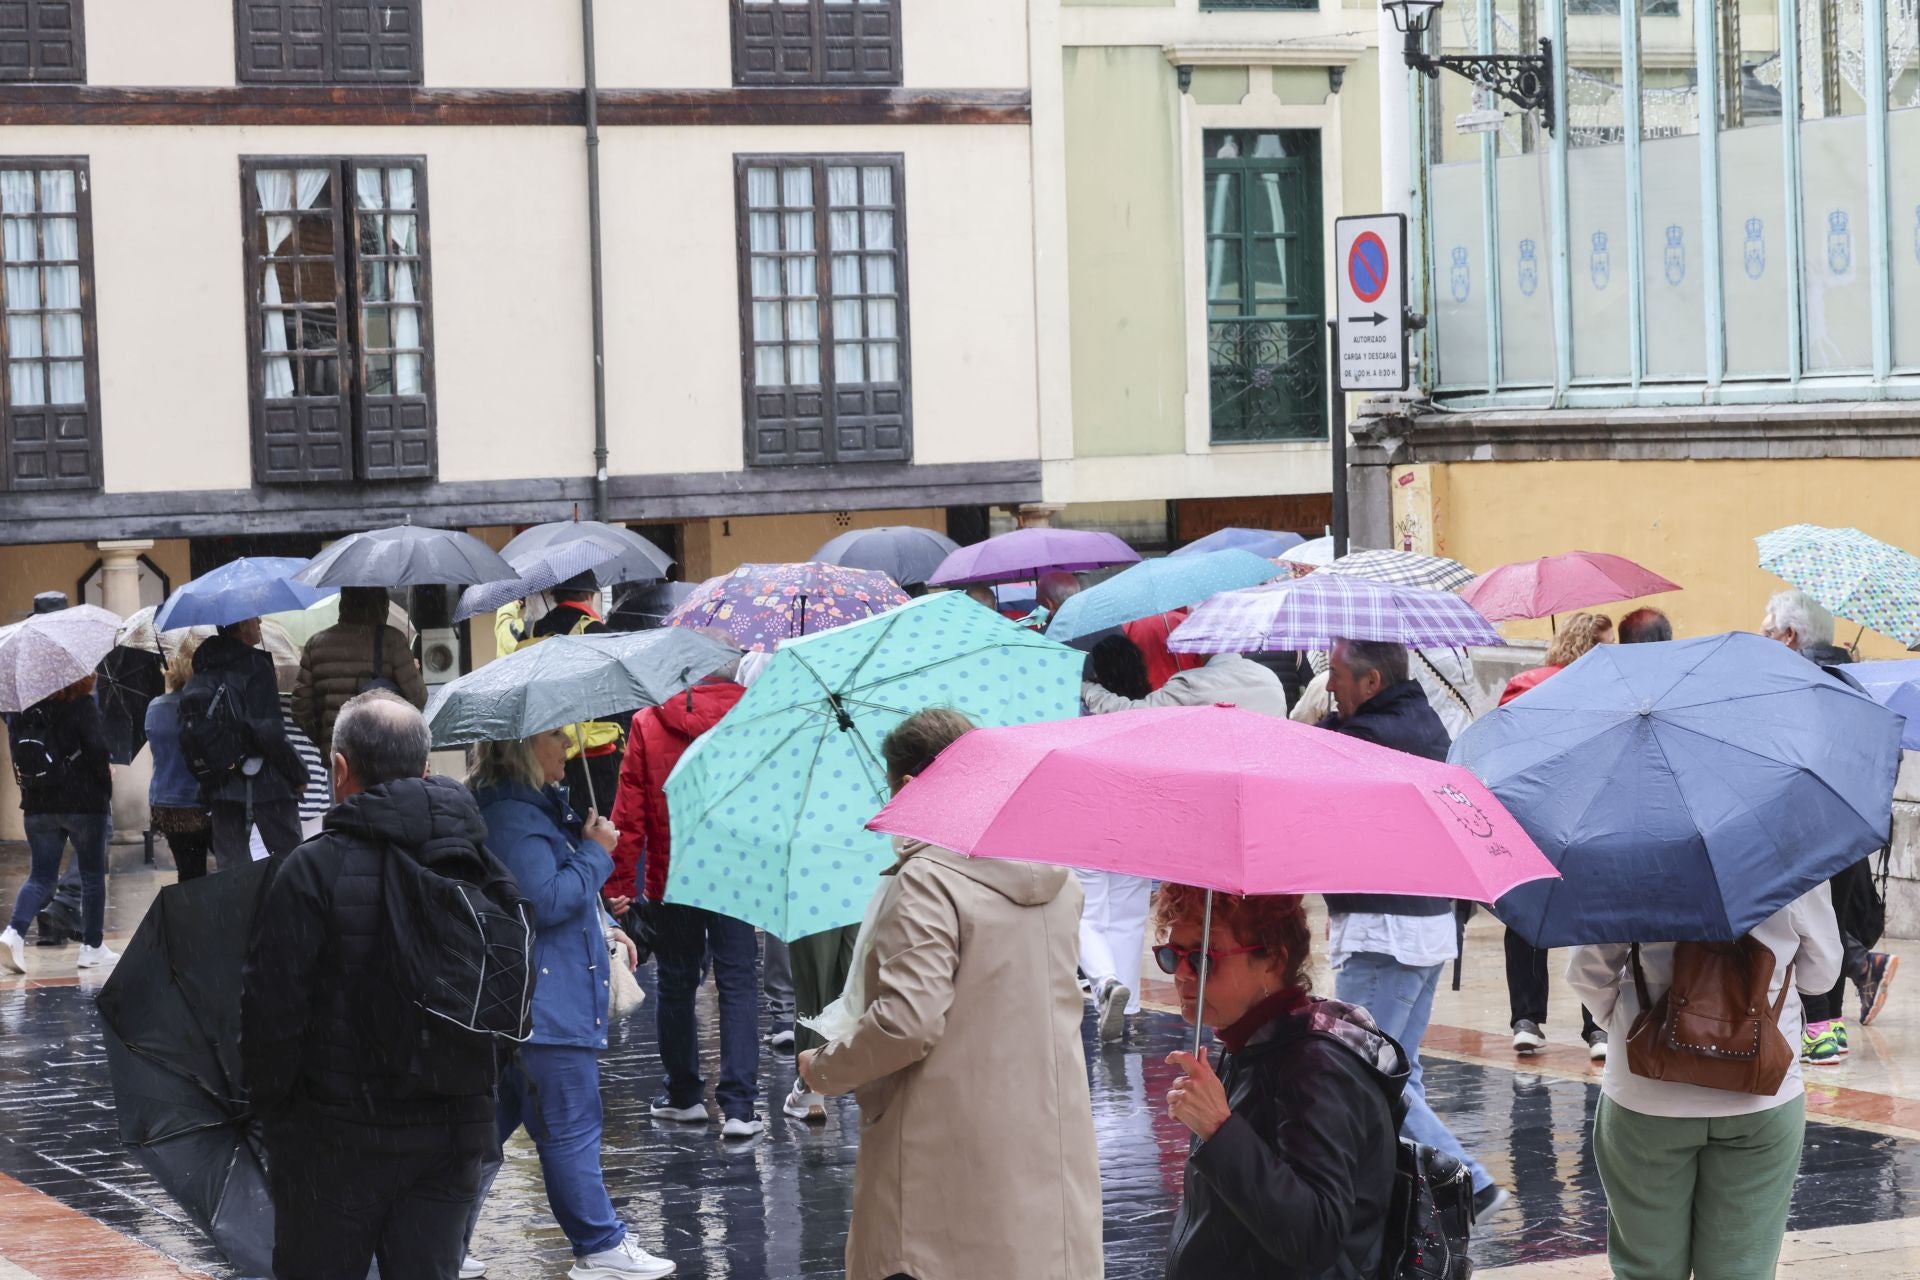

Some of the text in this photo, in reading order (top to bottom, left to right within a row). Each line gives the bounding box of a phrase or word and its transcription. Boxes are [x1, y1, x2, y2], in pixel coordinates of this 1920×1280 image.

[1353, 335, 1387, 344] AUTORIZADO
[1343, 353, 1362, 361] CARGA
[1368, 352, 1397, 360] DESCARGA
[1344, 369, 1352, 378] DE
[1373, 369, 1377, 377] A
[722, 519, 731, 537] 1
